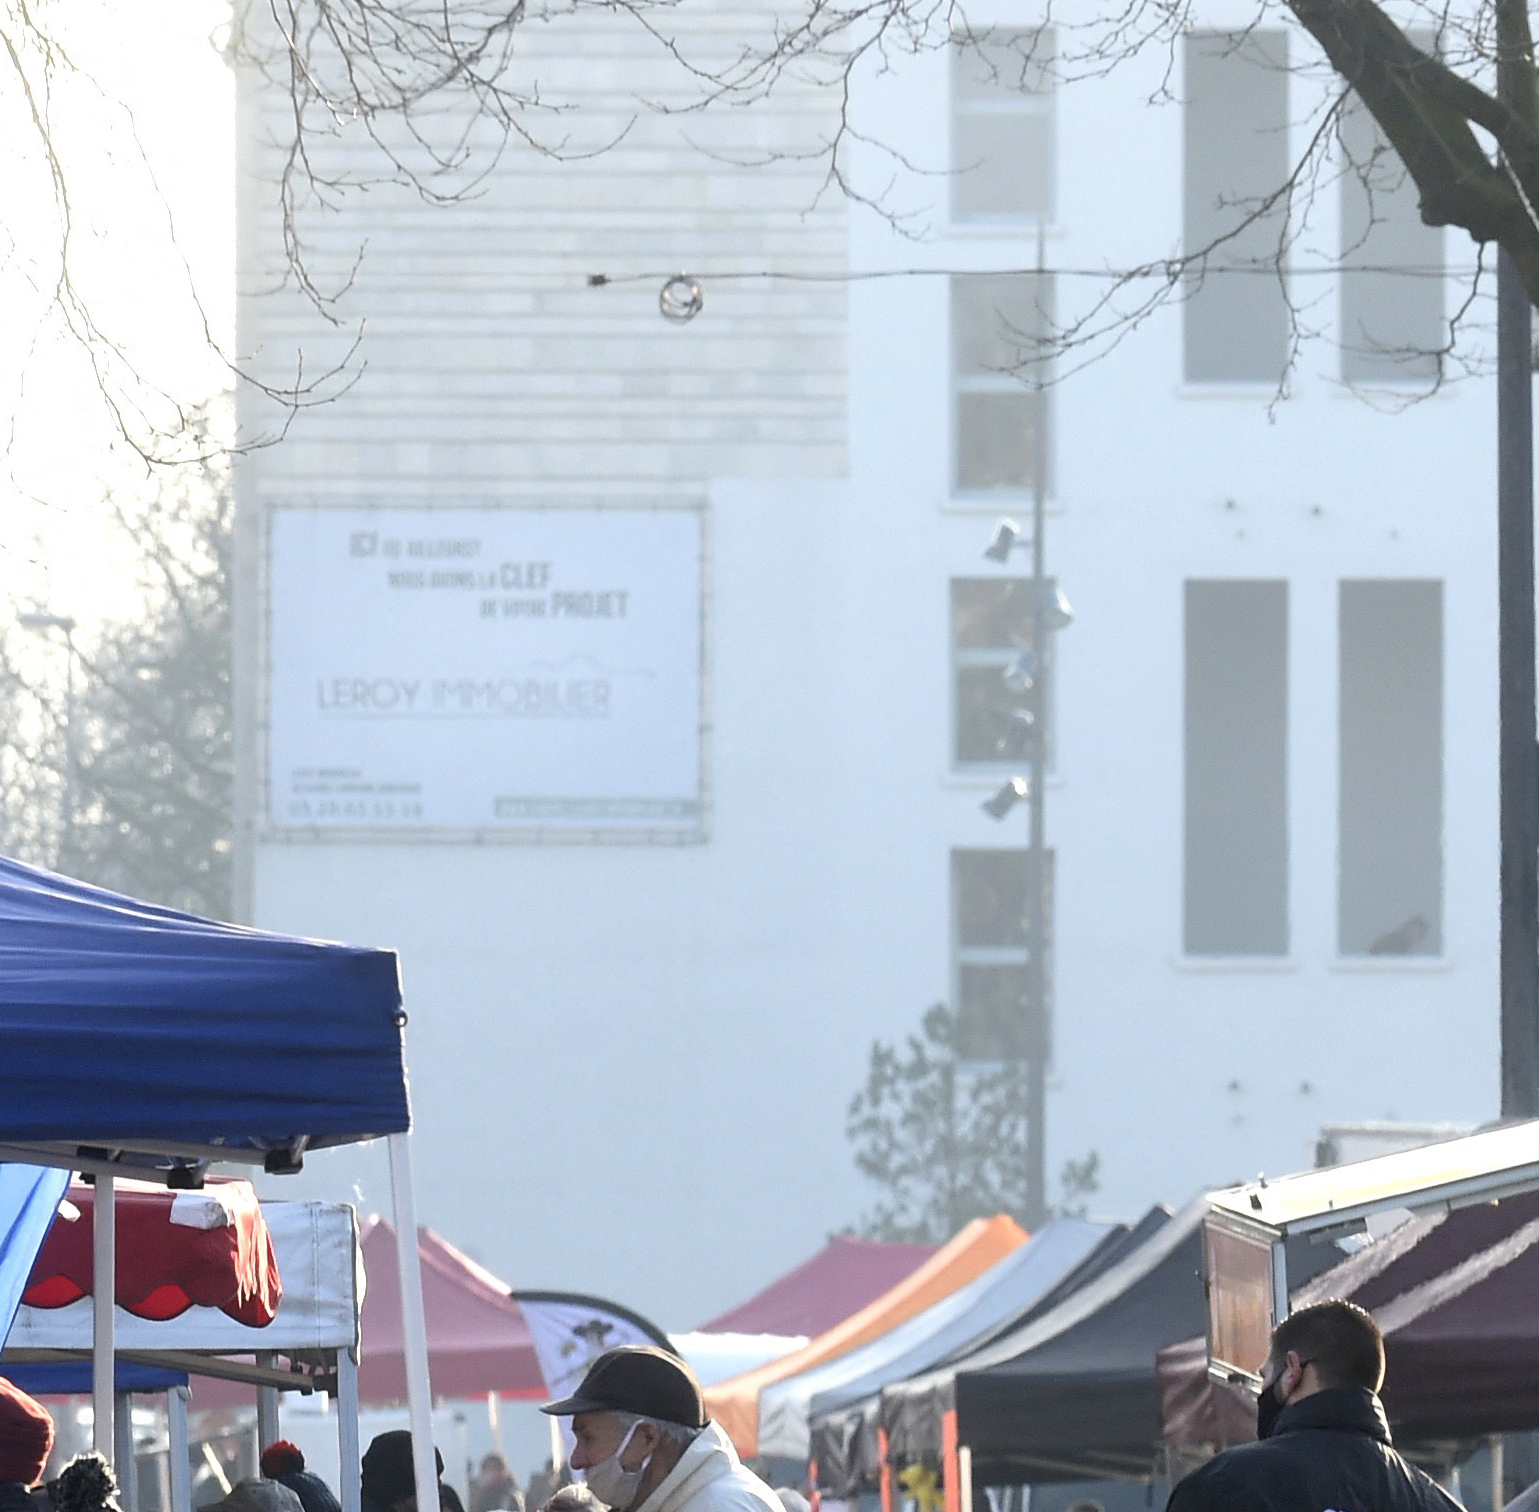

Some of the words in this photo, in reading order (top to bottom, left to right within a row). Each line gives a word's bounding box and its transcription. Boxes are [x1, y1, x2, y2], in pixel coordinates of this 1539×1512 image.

[499, 561, 554, 590] CLEF
[551, 590, 628, 619] PROJET
[316, 678, 422, 711] LEROY
[432, 678, 613, 712] IMMOBILIER
